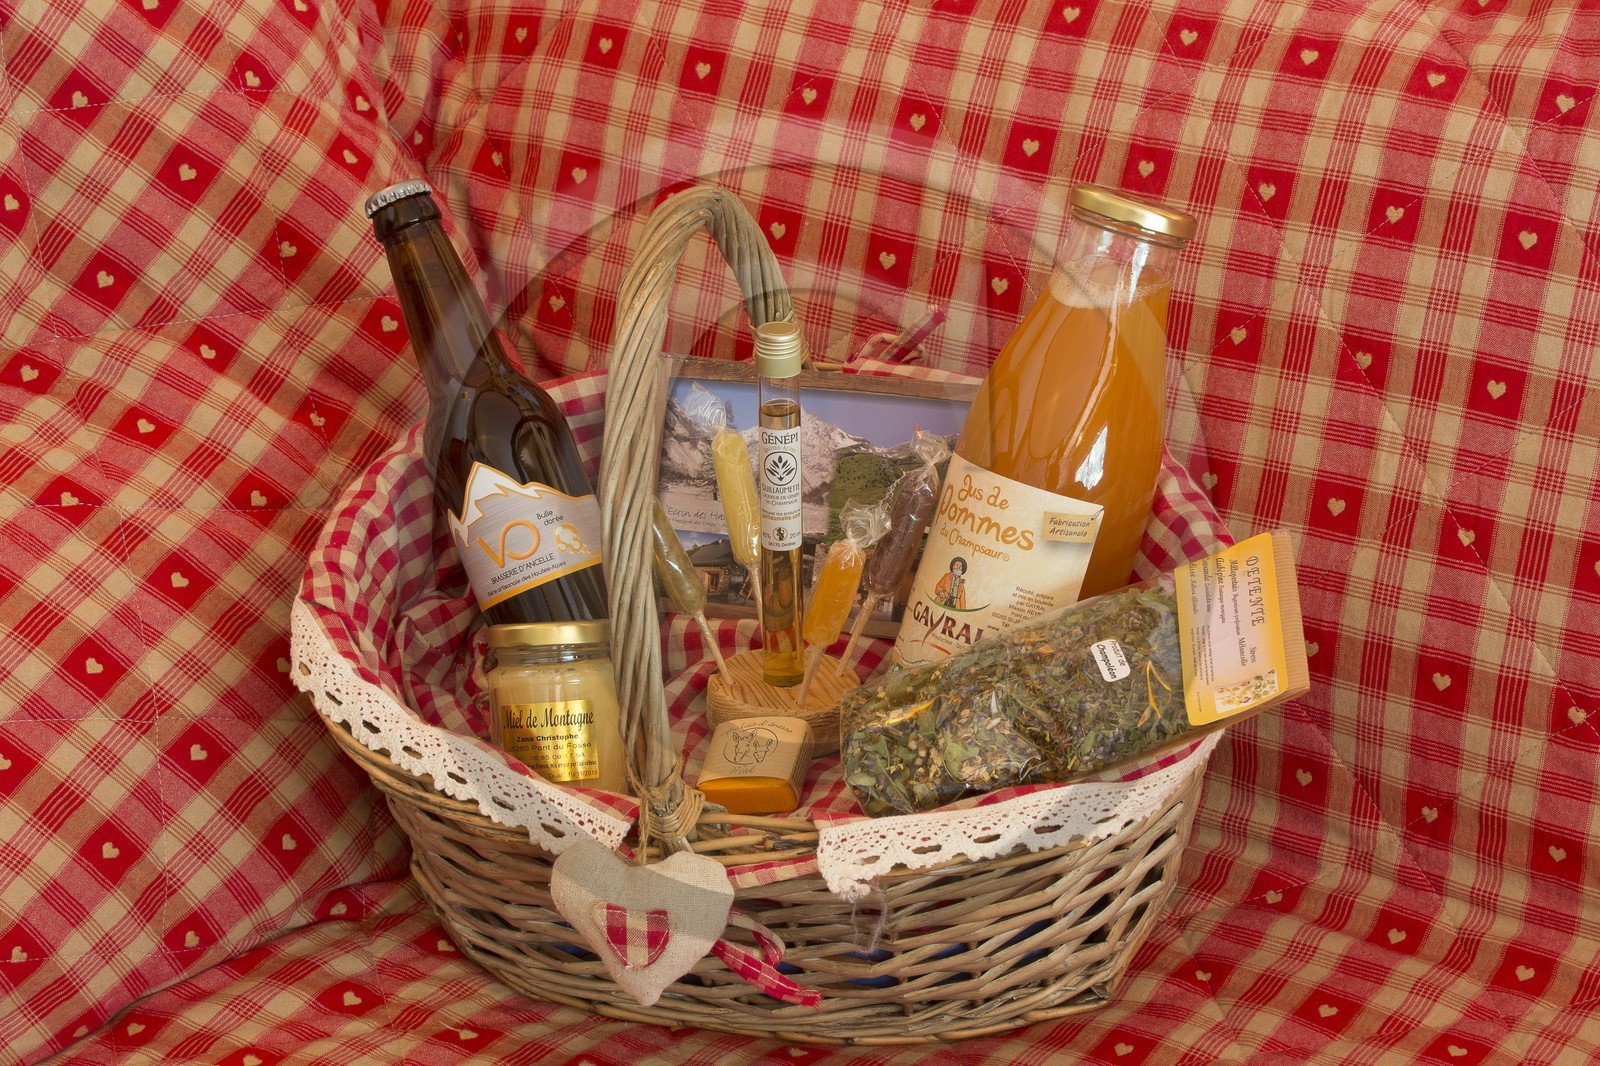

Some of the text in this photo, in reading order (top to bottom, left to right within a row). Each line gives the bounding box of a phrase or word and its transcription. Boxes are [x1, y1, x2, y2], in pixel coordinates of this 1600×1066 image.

[761, 431, 799, 445] GÉNÉPI
[761, 483, 800, 494] GUILLAUMETTE
[957, 474, 1010, 511] Jus de
[535, 509, 554, 521] Bulle
[543, 514, 564, 526] dorée
[693, 508, 707, 520] des
[935, 482, 1035, 551] Pommes
[1048, 517, 1091, 528] Fabrication
[939, 522, 948, 538] du
[1048, 527, 1088, 538] Artisanale
[490, 552, 555, 585] BRASSERIE D'ANCELLE
[521, 574, 531, 582] des
[531, 560, 567, 578] Hautes-Alpes
[1245, 555, 1265, 627] DETENTE
[1009, 604, 1026, 612] Maison
[1025, 602, 1046, 611] GAYRAL
[1011, 611, 1023, 619] Pont
[1237, 636, 1247, 667] Mélancolie
[1096, 644, 1117, 680] Champoléon
[504, 707, 594, 731] Miel de Montagne
[536, 733, 579, 742] Christophe
[729, 765, 756, 775] Miel
